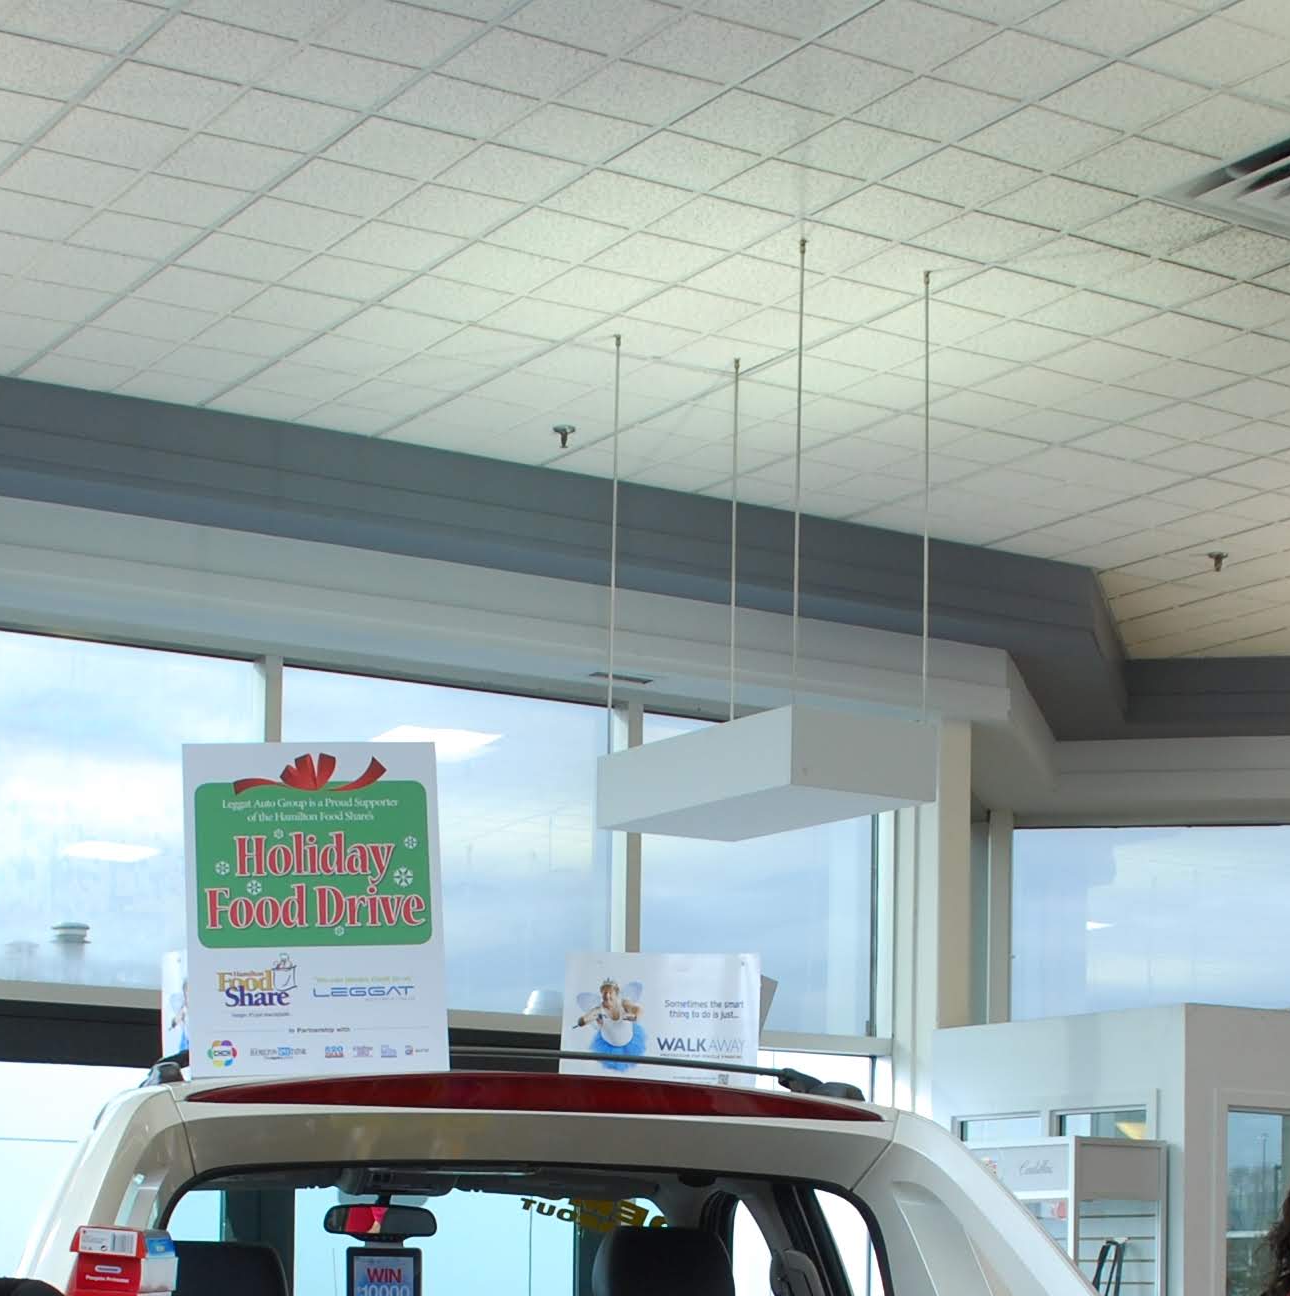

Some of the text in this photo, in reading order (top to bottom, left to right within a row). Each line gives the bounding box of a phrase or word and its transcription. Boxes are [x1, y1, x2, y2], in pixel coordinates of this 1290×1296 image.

[222, 799, 251, 811] Leggat
[253, 799, 276, 808] Auto
[277, 798, 307, 810] Group
[309, 798, 316, 808] is
[325, 797, 352, 808] Proud
[354, 797, 399, 810] Supporter
[246, 811, 257, 822] of
[259, 811, 274, 821] the
[275, 811, 318, 821] Hamilton
[320, 811, 343, 821] Food
[233, 830, 396, 885] Holiday
[204, 883, 427, 930] Food Drive
[217, 969, 274, 993] Food
[225, 985, 291, 1007] Share
[313, 985, 415, 998] LEGGAT
[664, 1000, 744, 1010] Sometimes the smart
[669, 1010, 689, 1020] thing
[691, 1011, 700, 1019] to
[701, 1010, 711, 1019] do
[713, 1010, 719, 1019] is
[366, 1267, 402, 1284] WIN
